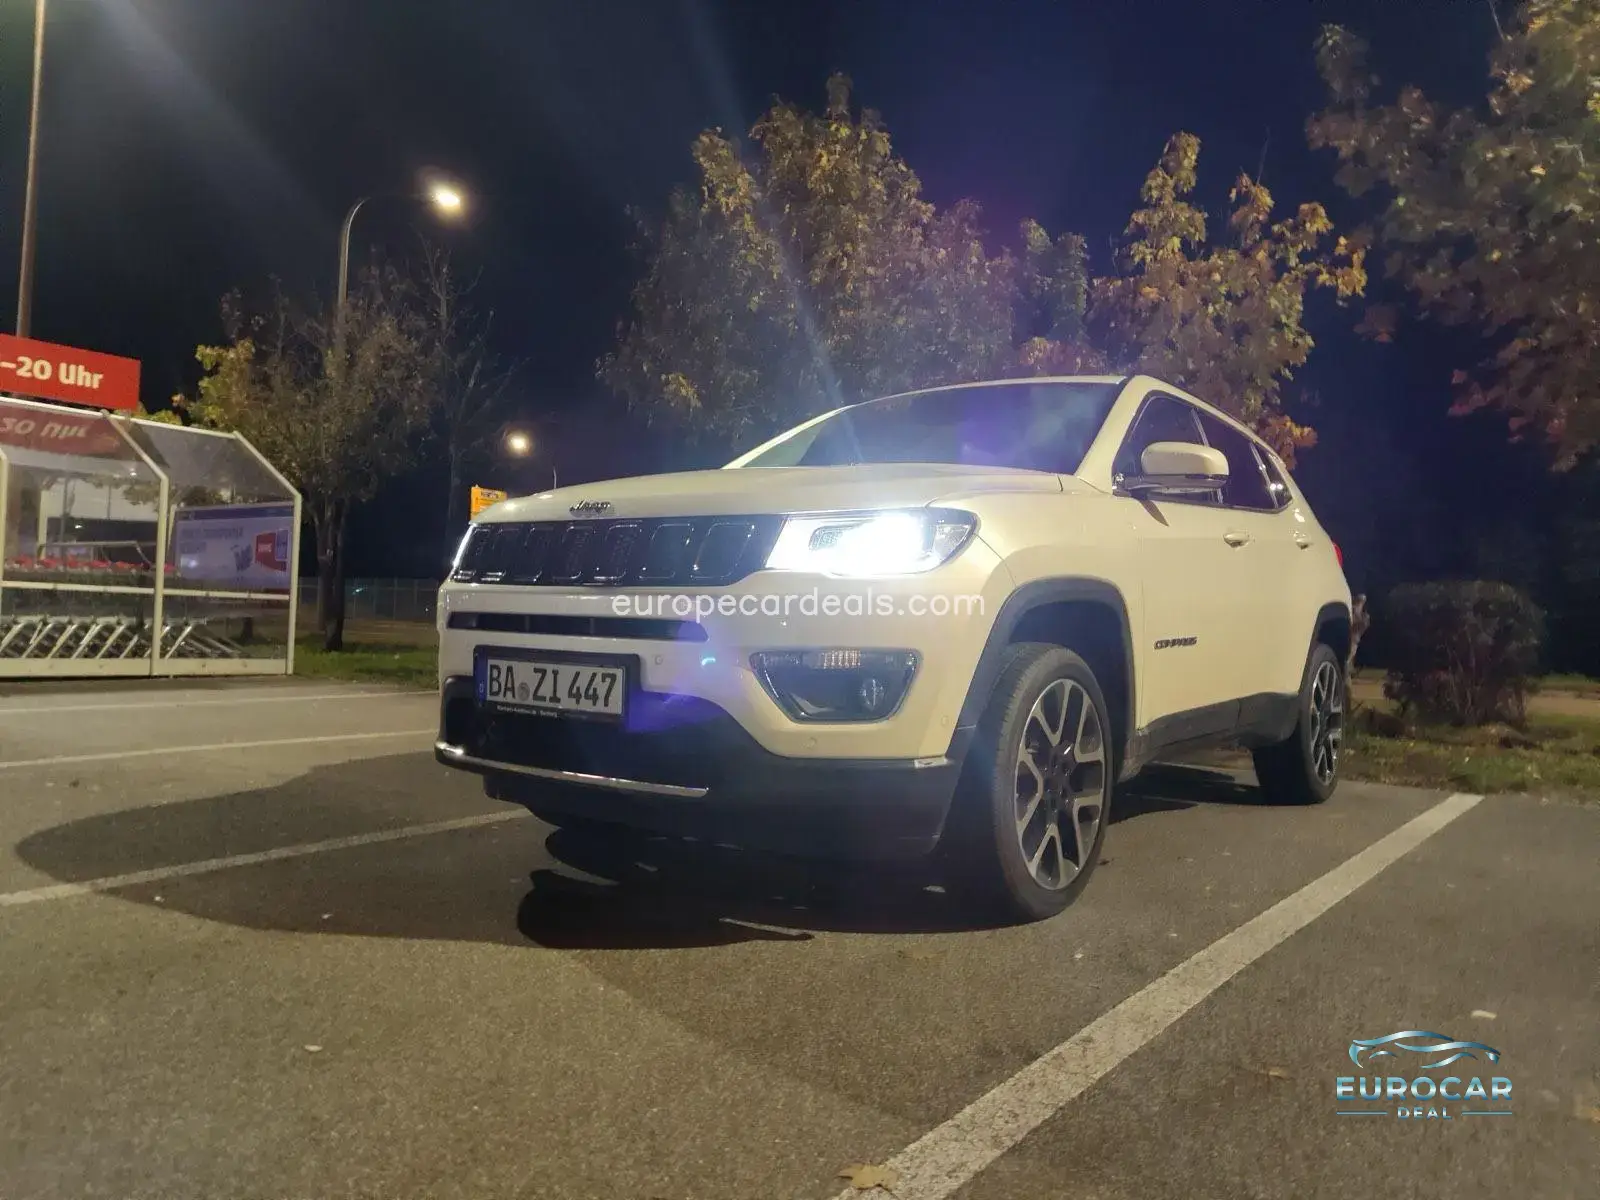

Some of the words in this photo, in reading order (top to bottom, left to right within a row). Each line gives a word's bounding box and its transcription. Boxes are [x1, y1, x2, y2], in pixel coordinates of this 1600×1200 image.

[59, 362, 104, 389] Uhr
[569, 499, 612, 514] Jeep
[489, 664, 516, 699] BA
[532, 667, 561, 703] ZI
[567, 671, 617, 707] 447
